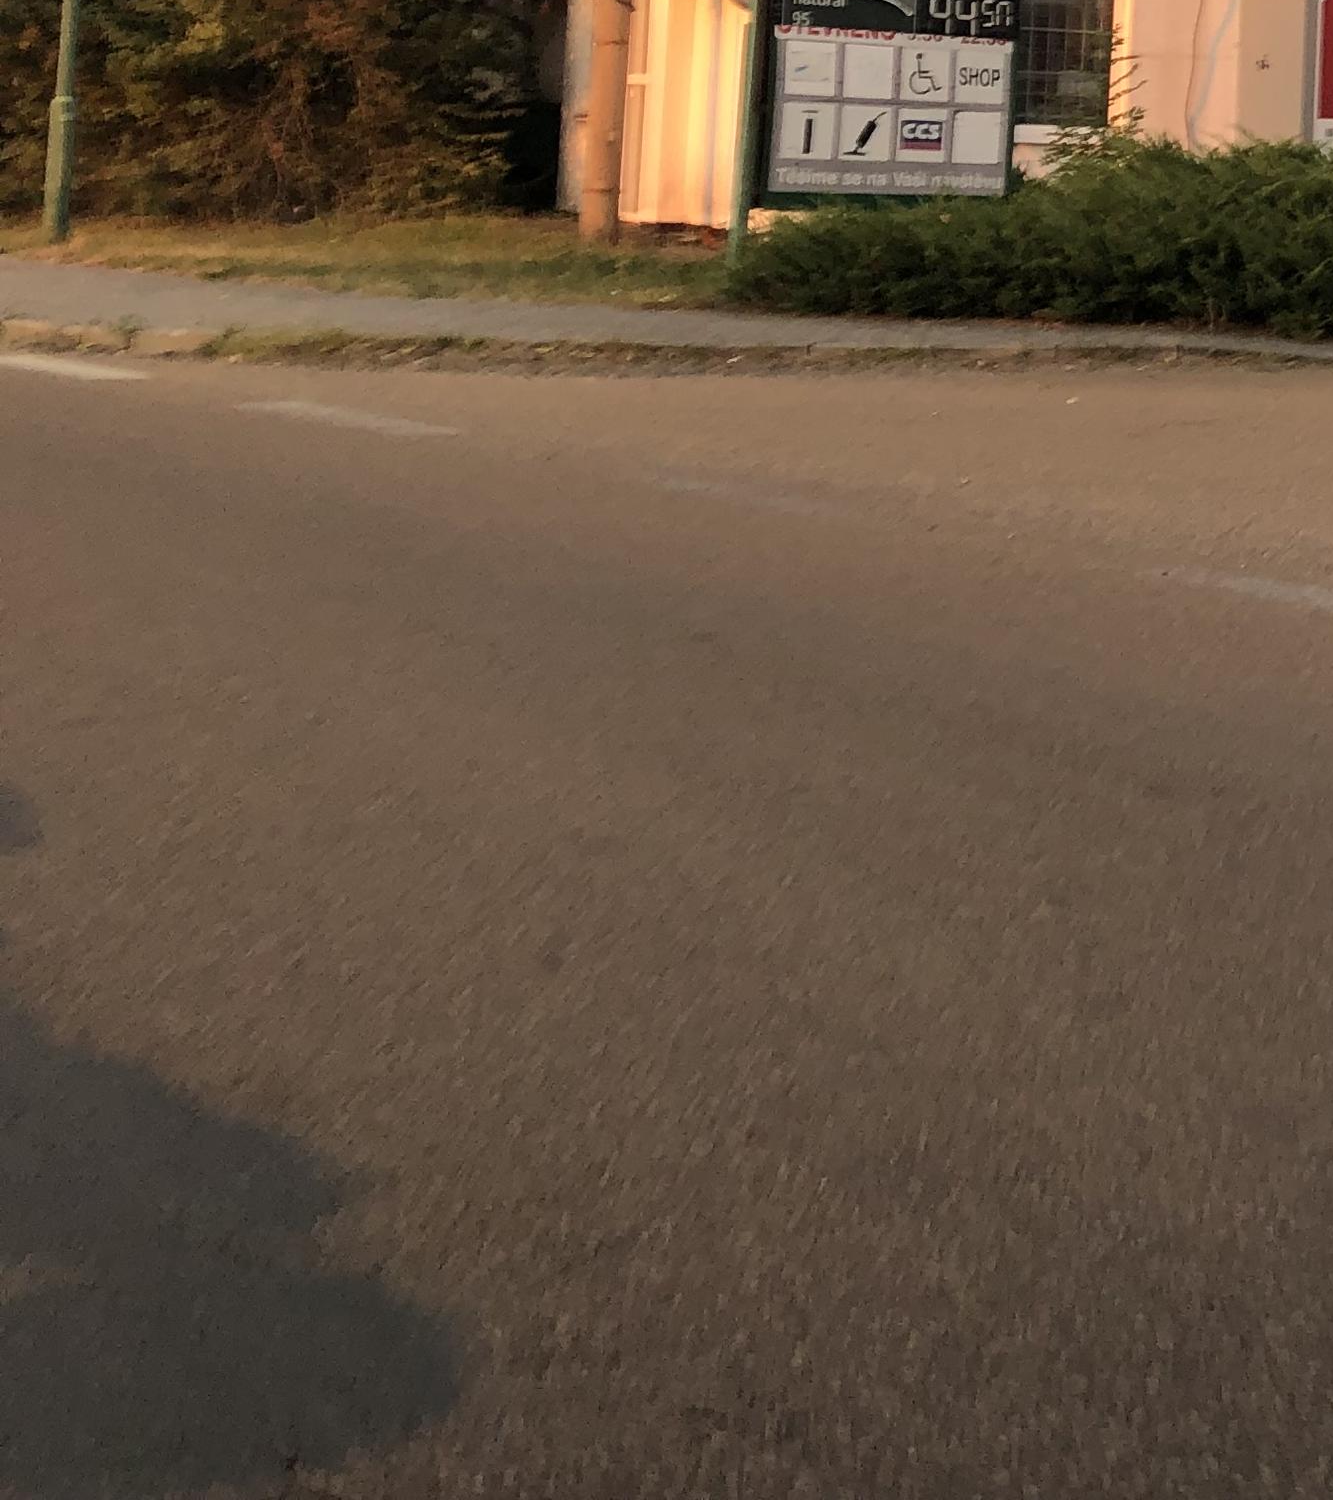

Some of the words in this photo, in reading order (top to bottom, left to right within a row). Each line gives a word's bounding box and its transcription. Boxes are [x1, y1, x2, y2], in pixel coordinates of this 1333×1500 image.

[792, 11, 811, 25] 95
[959, 67, 1000, 87] SHOP
[902, 122, 941, 140] CCS
[866, 172, 887, 186] na
